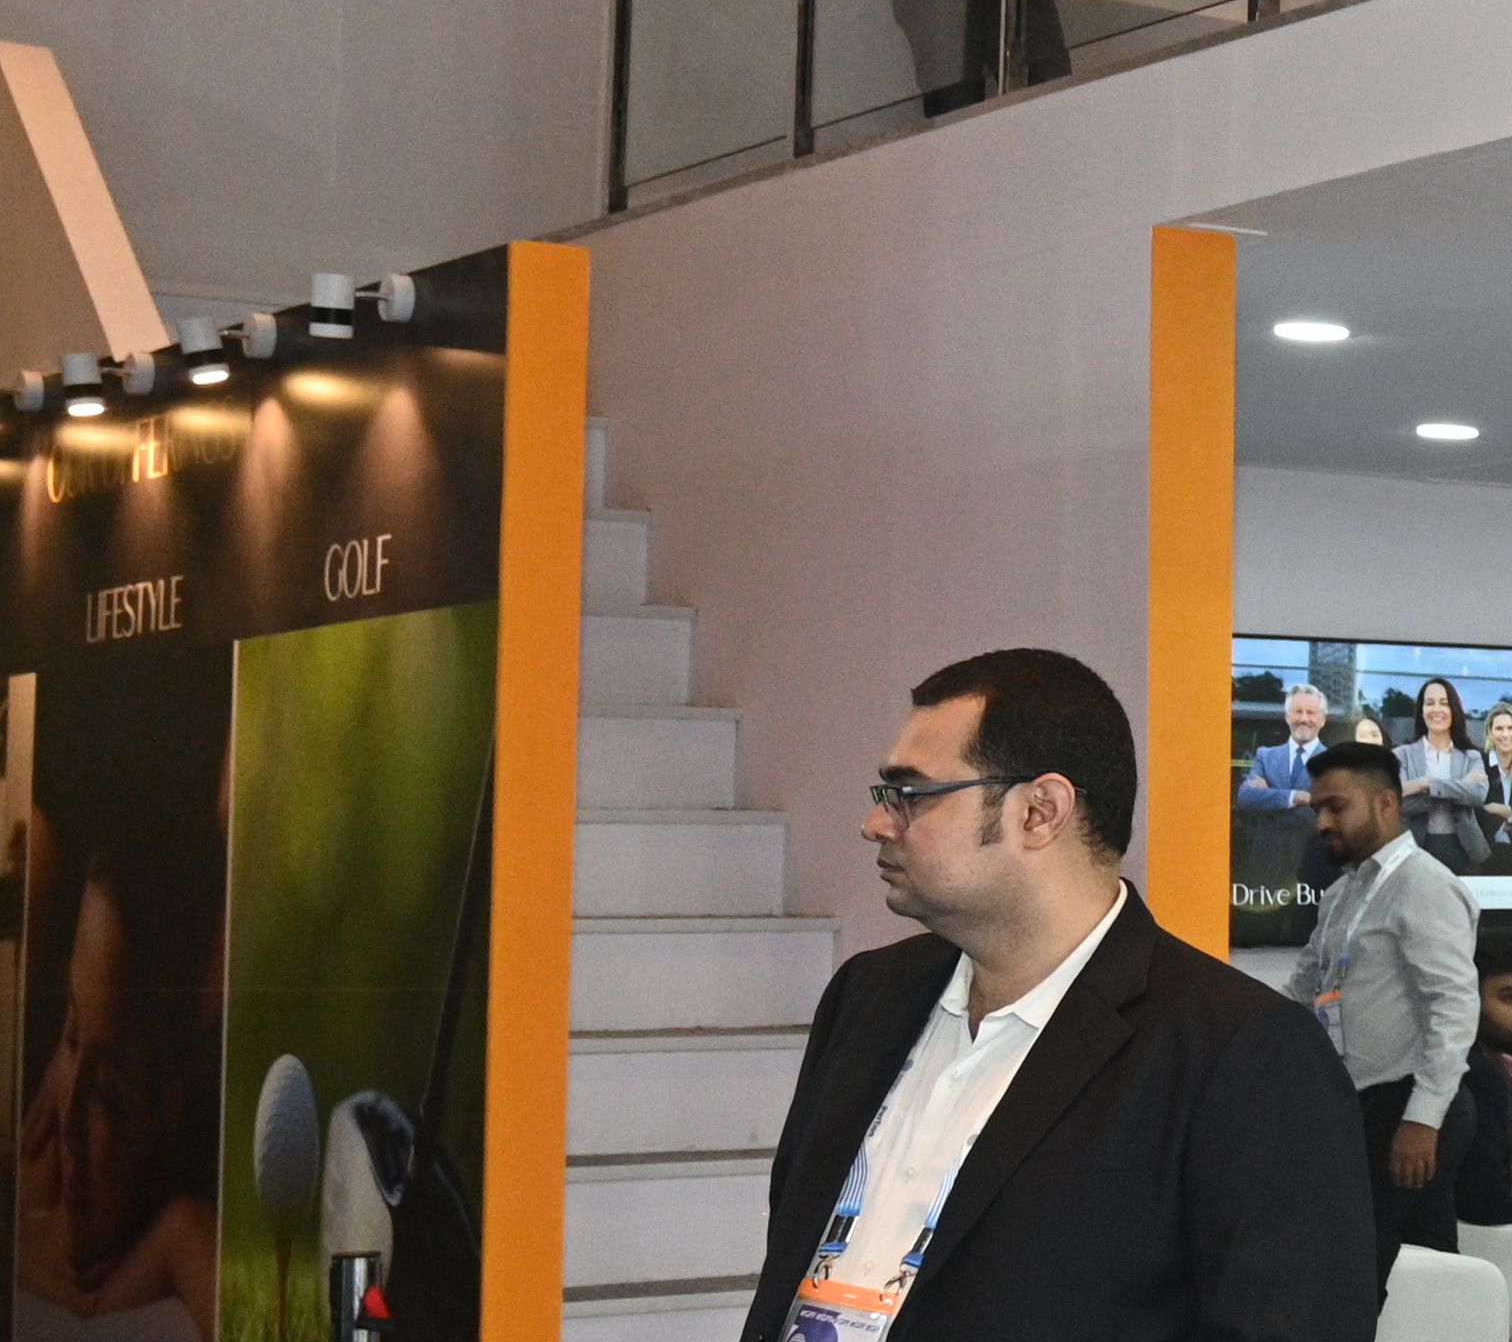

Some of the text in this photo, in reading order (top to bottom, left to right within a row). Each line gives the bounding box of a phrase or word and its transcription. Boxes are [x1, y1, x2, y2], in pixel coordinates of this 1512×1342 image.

[323, 533, 393, 604] GOLF
[86, 575, 184, 644] LIFESTYLE
[1232, 882, 1291, 907] Drive
